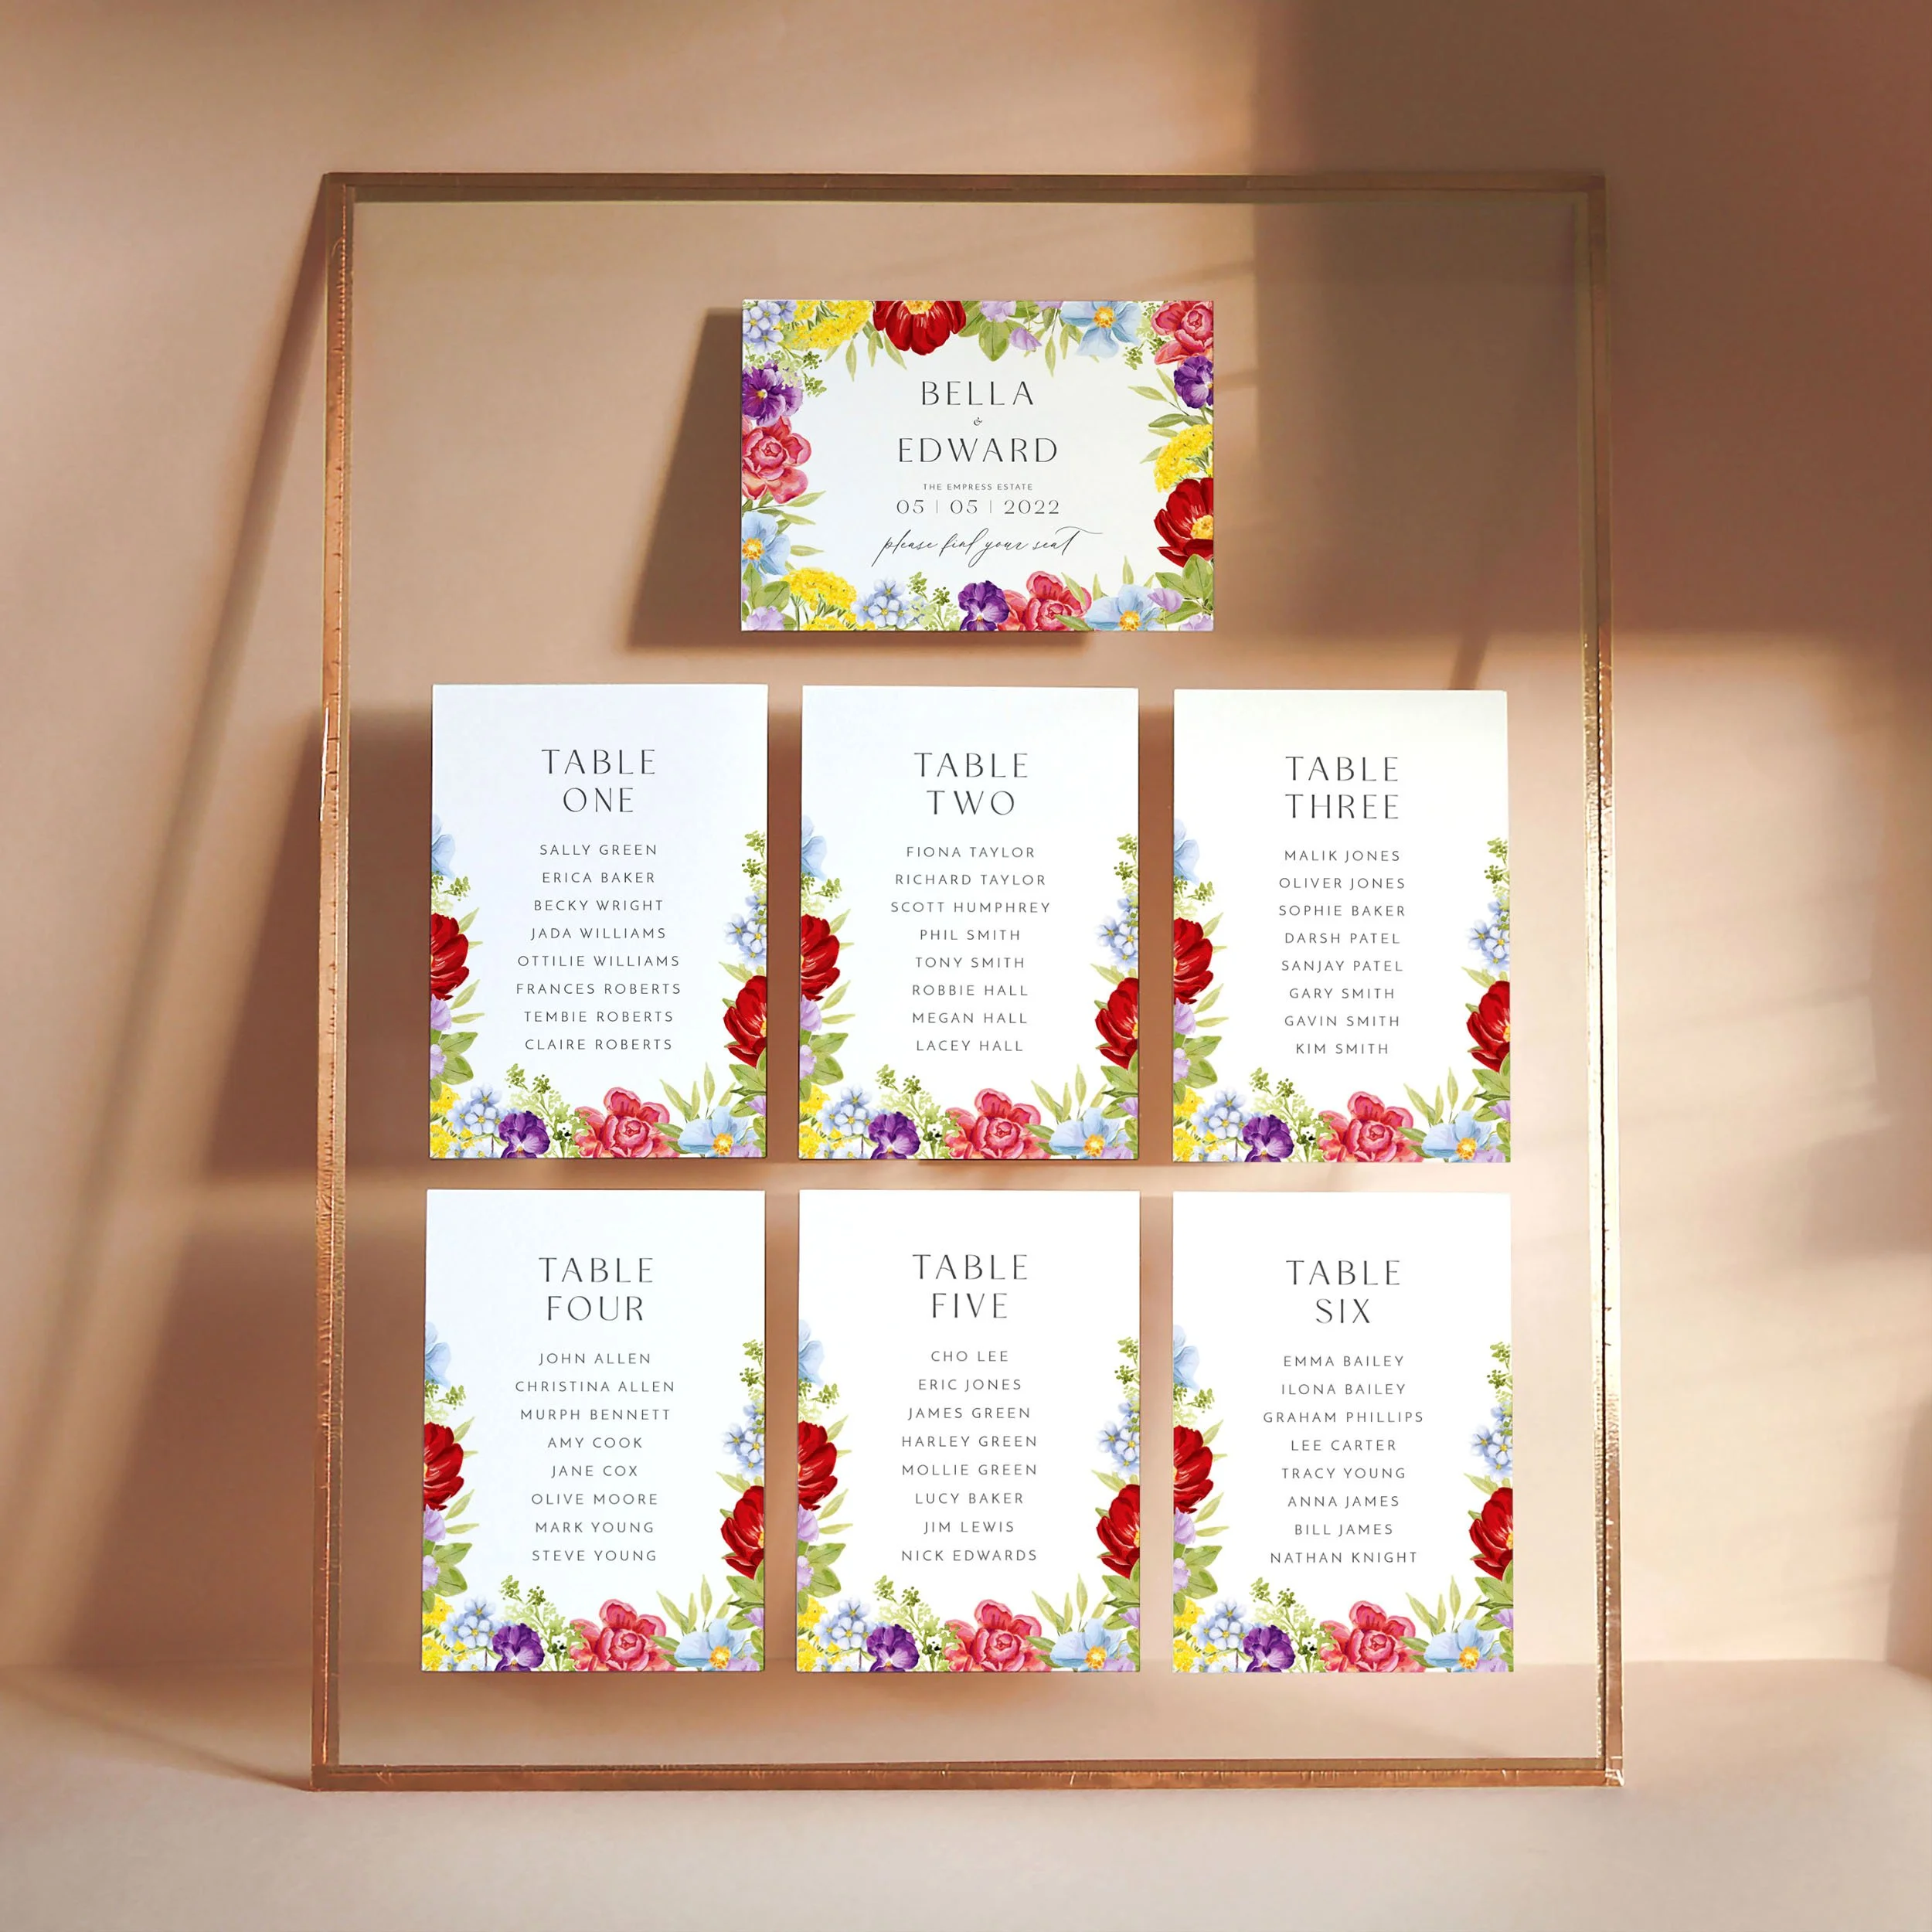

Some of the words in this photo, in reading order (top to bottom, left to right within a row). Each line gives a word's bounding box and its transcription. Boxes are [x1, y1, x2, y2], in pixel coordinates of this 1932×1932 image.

[922, 380, 1034, 406] BELLA
[973, 417, 983, 427] &
[899, 437, 1057, 463] EDWARD
[896, 499, 924, 515] 05
[950, 499, 978, 515] 05
[1004, 499, 1060, 515] 2022
[871, 529, 938, 567] please
[938, 527, 989, 556] find
[968, 540, 1029, 568] your
[1032, 526, 1104, 556] seat
[541, 749, 655, 775] TABLE
[913, 752, 1028, 778] TABLE
[1285, 756, 1398, 782] TABLE
[563, 787, 634, 813] ONE
[926, 790, 1015, 816] TWO
[1284, 794, 1399, 819] THREE
[539, 844, 591, 855] SALLY
[599, 844, 656, 855] GREEN
[906, 846, 961, 858] FIONA
[969, 846, 1035, 859] TAYLOR
[1284, 849, 1338, 862] MALIK
[1344, 850, 1400, 864] JONES
[543, 872, 592, 883] ERICA
[600, 872, 655, 883] BAKER
[896, 873, 971, 886] RICHARD
[980, 874, 1046, 886] TAYLOR
[1279, 877, 1342, 889] OLIVER
[1349, 877, 1405, 891] JONES
[534, 900, 588, 911] BECKY
[596, 900, 663, 911] WRIGHT
[890, 901, 945, 913] SCOTT
[954, 902, 1050, 913] HUMPHREY
[1278, 904, 1342, 917] SOPHIE
[1352, 905, 1405, 917] BAKER
[530, 927, 572, 941] JADA
[580, 927, 665, 939] WILLIAMS
[920, 929, 958, 940] PHIL
[966, 929, 1020, 940] SMITH
[1285, 932, 1340, 944] DARSH
[1350, 933, 1400, 944] PATEL
[517, 955, 585, 967] OTTILIE
[593, 955, 679, 967] WILLIAMS
[915, 957, 963, 968] TONY
[971, 957, 1024, 968] SMITH
[1281, 960, 1345, 974] SANJAY
[1353, 960, 1403, 972] PATEL
[516, 983, 595, 995] FRANCES
[604, 983, 681, 995] ROBERTS
[912, 984, 975, 996] ROBBIE
[984, 985, 1029, 996] HALL
[1289, 988, 1333, 999] GARY
[1341, 988, 1394, 999] SMITH
[524, 1011, 587, 1022] TEMBIE
[597, 1011, 673, 1022] ROBERTS
[912, 1012, 974, 1024] MEGAN
[984, 1012, 1027, 1024] HALL
[1284, 1015, 1337, 1027] GAVIN
[1346, 1015, 1399, 1027] SMITH
[525, 1039, 586, 1050] CLAIRE
[595, 1039, 672, 1050] ROBERTS
[917, 1039, 971, 1052] LACEY
[979, 1040, 1023, 1052] HALL
[1296, 1043, 1326, 1055] KIM
[1335, 1043, 1388, 1055] SMITH
[538, 1257, 653, 1283] TABLE
[912, 1253, 1028, 1281] TABLE
[1285, 1260, 1400, 1286] TABLE
[547, 1295, 643, 1321] FOUR
[932, 1292, 1008, 1319] FIVE
[1315, 1298, 1371, 1324] SIX
[538, 1352, 585, 1366] JOHN
[594, 1352, 650, 1365] ALLEN
[930, 1350, 968, 1362] CHO
[978, 1350, 1009, 1362] LEE
[1284, 1355, 1335, 1367] EMMA
[1343, 1355, 1404, 1367] BAILEY
[515, 1380, 611, 1393] CHRISTINA
[617, 1380, 674, 1393] ALLEN
[918, 1379, 957, 1390] ERIC
[964, 1379, 1021, 1393] JONES
[1281, 1383, 1336, 1396] ILONA
[1345, 1383, 1406, 1395] BAILEY
[520, 1409, 580, 1420] MURPH
[590, 1409, 670, 1420] BENNETT
[907, 1407, 963, 1421] JAMES
[971, 1407, 1030, 1419] GREEN
[1263, 1411, 1336, 1423] GRAHAM
[1346, 1411, 1423, 1423] PHILLIPS
[547, 1437, 584, 1449] AMY
[592, 1437, 642, 1448] COOK
[902, 1435, 970, 1447] HARLEY
[978, 1435, 1036, 1447] GREEN
[1291, 1440, 1321, 1451] LEE
[1331, 1439, 1396, 1451] CARTER
[550, 1464, 594, 1479] JANE
[603, 1464, 638, 1477] COX
[902, 1464, 969, 1476] MOLLIE
[978, 1464, 1036, 1476] GREEN
[1281, 1468, 1335, 1479] TRACY
[1343, 1467, 1405, 1479] YOUNG
[531, 1493, 584, 1505] OLIVE
[594, 1493, 658, 1505] MOORE
[915, 1492, 960, 1505] LUCY
[968, 1492, 1023, 1505] BAKER
[1287, 1495, 1338, 1508] ANNA
[1344, 1495, 1399, 1509] JAMES
[536, 1522, 583, 1533] MARK
[590, 1522, 653, 1533] YOUNG
[923, 1521, 951, 1535] JIM
[961, 1521, 1014, 1533] LEWIS
[1294, 1523, 1332, 1536] BILL
[1337, 1523, 1393, 1538] JAMES
[532, 1549, 585, 1562] STEVE
[594, 1549, 656, 1562] YOUNG
[902, 1549, 944, 1562] NICK
[953, 1549, 1037, 1562] EDWARDS
[1270, 1552, 1342, 1564] NATHAN
[1352, 1551, 1417, 1563] KNIGHT
